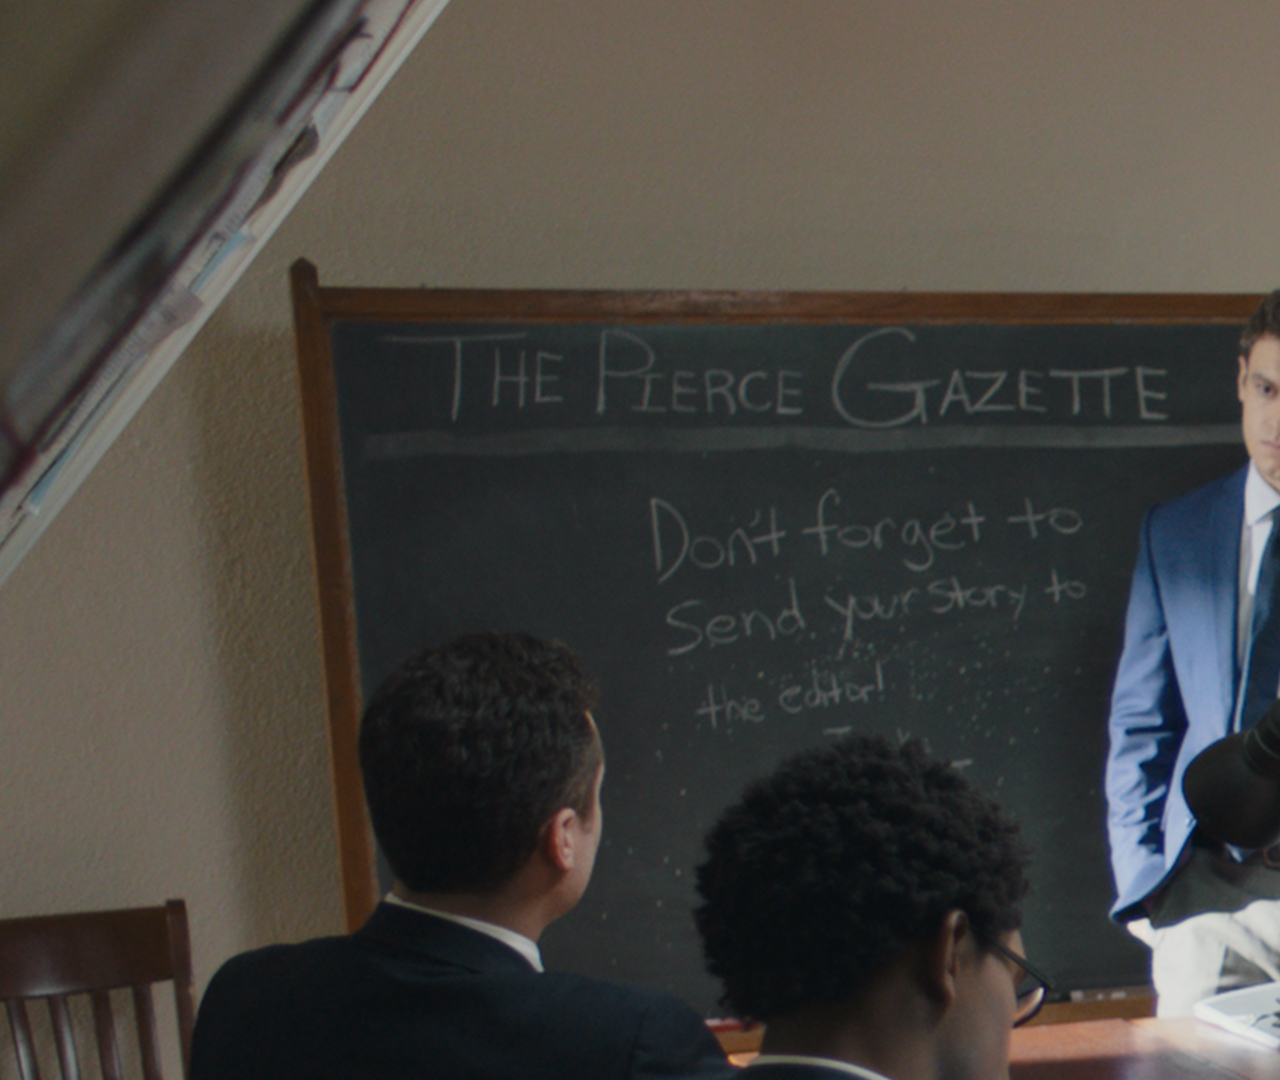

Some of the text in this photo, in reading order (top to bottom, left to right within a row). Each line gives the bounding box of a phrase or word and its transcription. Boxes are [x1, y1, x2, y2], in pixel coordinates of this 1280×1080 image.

[383, 326, 1168, 428] THE PIERCE GAZETTE
[650, 487, 1083, 584] Don't forget to
[666, 567, 1087, 661] Send your story to
[696, 659, 886, 729] the editor!
